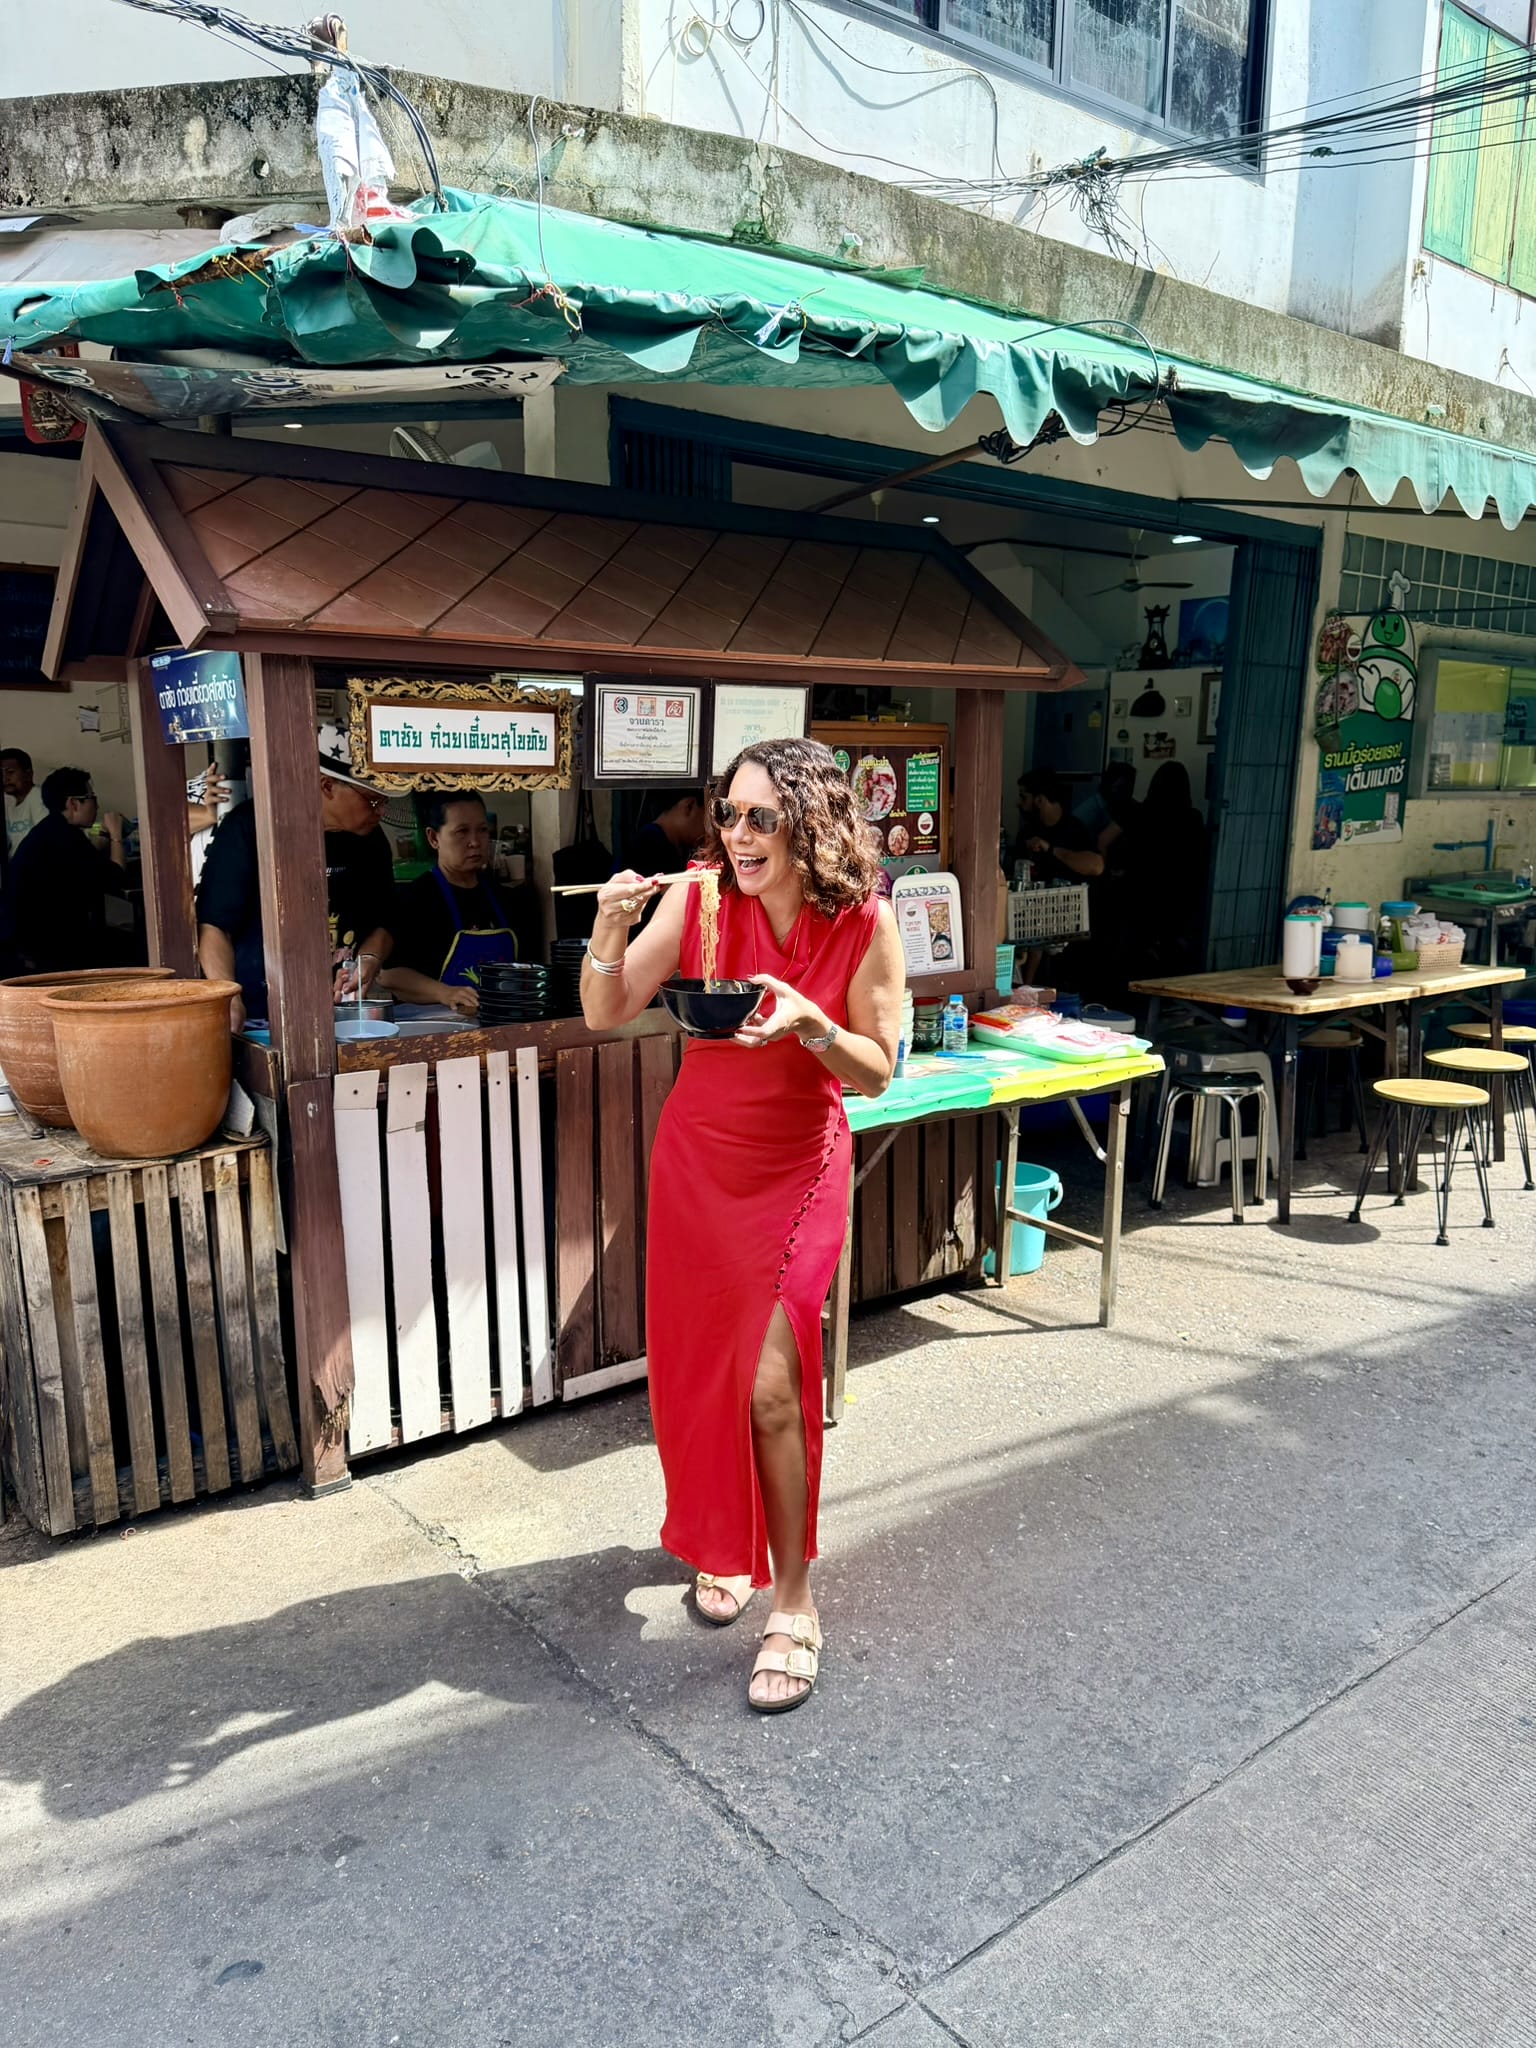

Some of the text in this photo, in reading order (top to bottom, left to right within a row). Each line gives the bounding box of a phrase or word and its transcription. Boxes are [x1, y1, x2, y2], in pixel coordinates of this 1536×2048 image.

[379, 715, 548, 757] ตาชัย ก๋วยเตี๋ยวสุโขทัย
[1324, 742, 1403, 768] รานนี้อร่อยแรง!
[1344, 758, 1407, 792] เต็มแมกซ์
